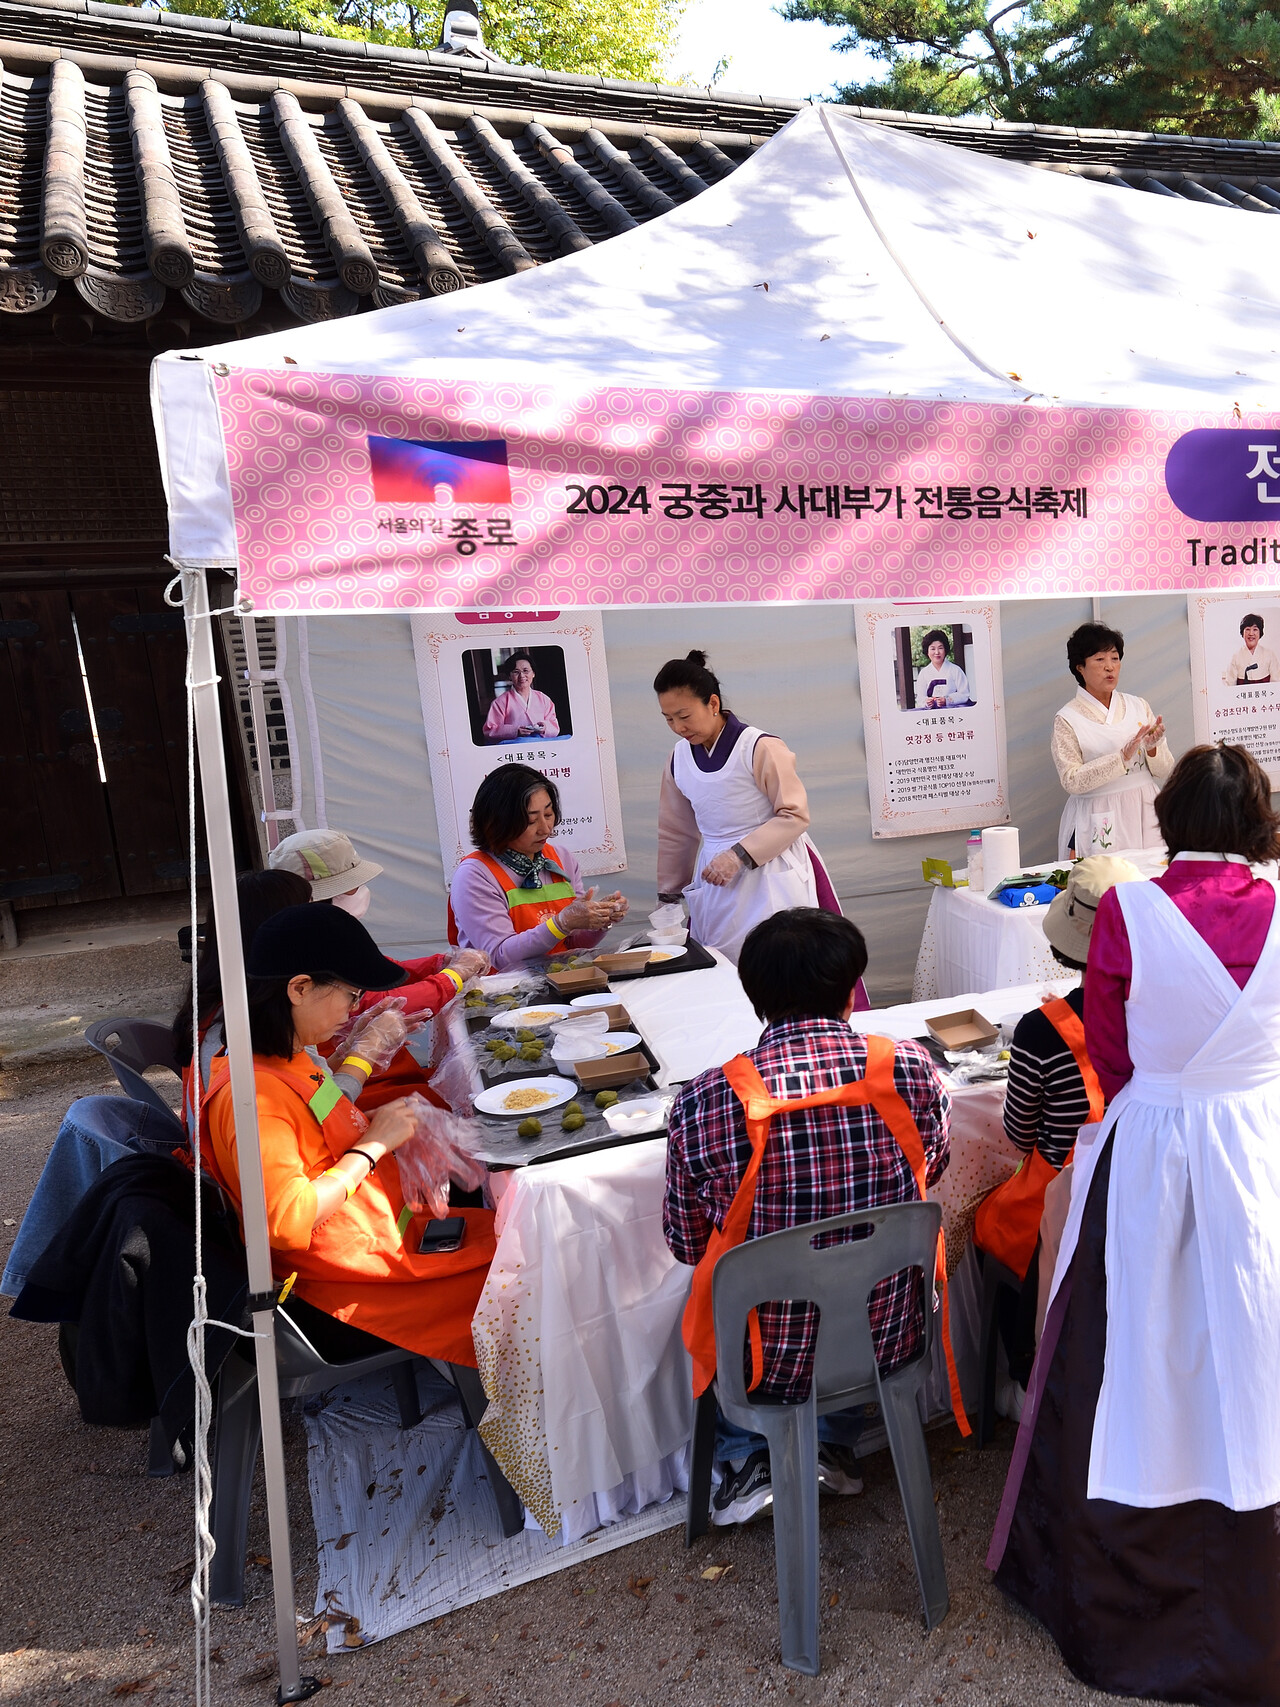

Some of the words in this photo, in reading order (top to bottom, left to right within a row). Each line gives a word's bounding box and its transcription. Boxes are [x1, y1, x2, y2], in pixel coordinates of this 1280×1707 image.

[565, 484, 651, 515] 2024
[658, 483, 767, 520] 궁중과
[773, 485, 907, 520] 사대부가
[913, 485, 1088, 520] 전통음식축제
[448, 518, 518, 556] 종로
[905, 734, 932, 745] 엿강정
[936, 733, 944, 743] 등
[755, 1471, 771, 1481] FIL
